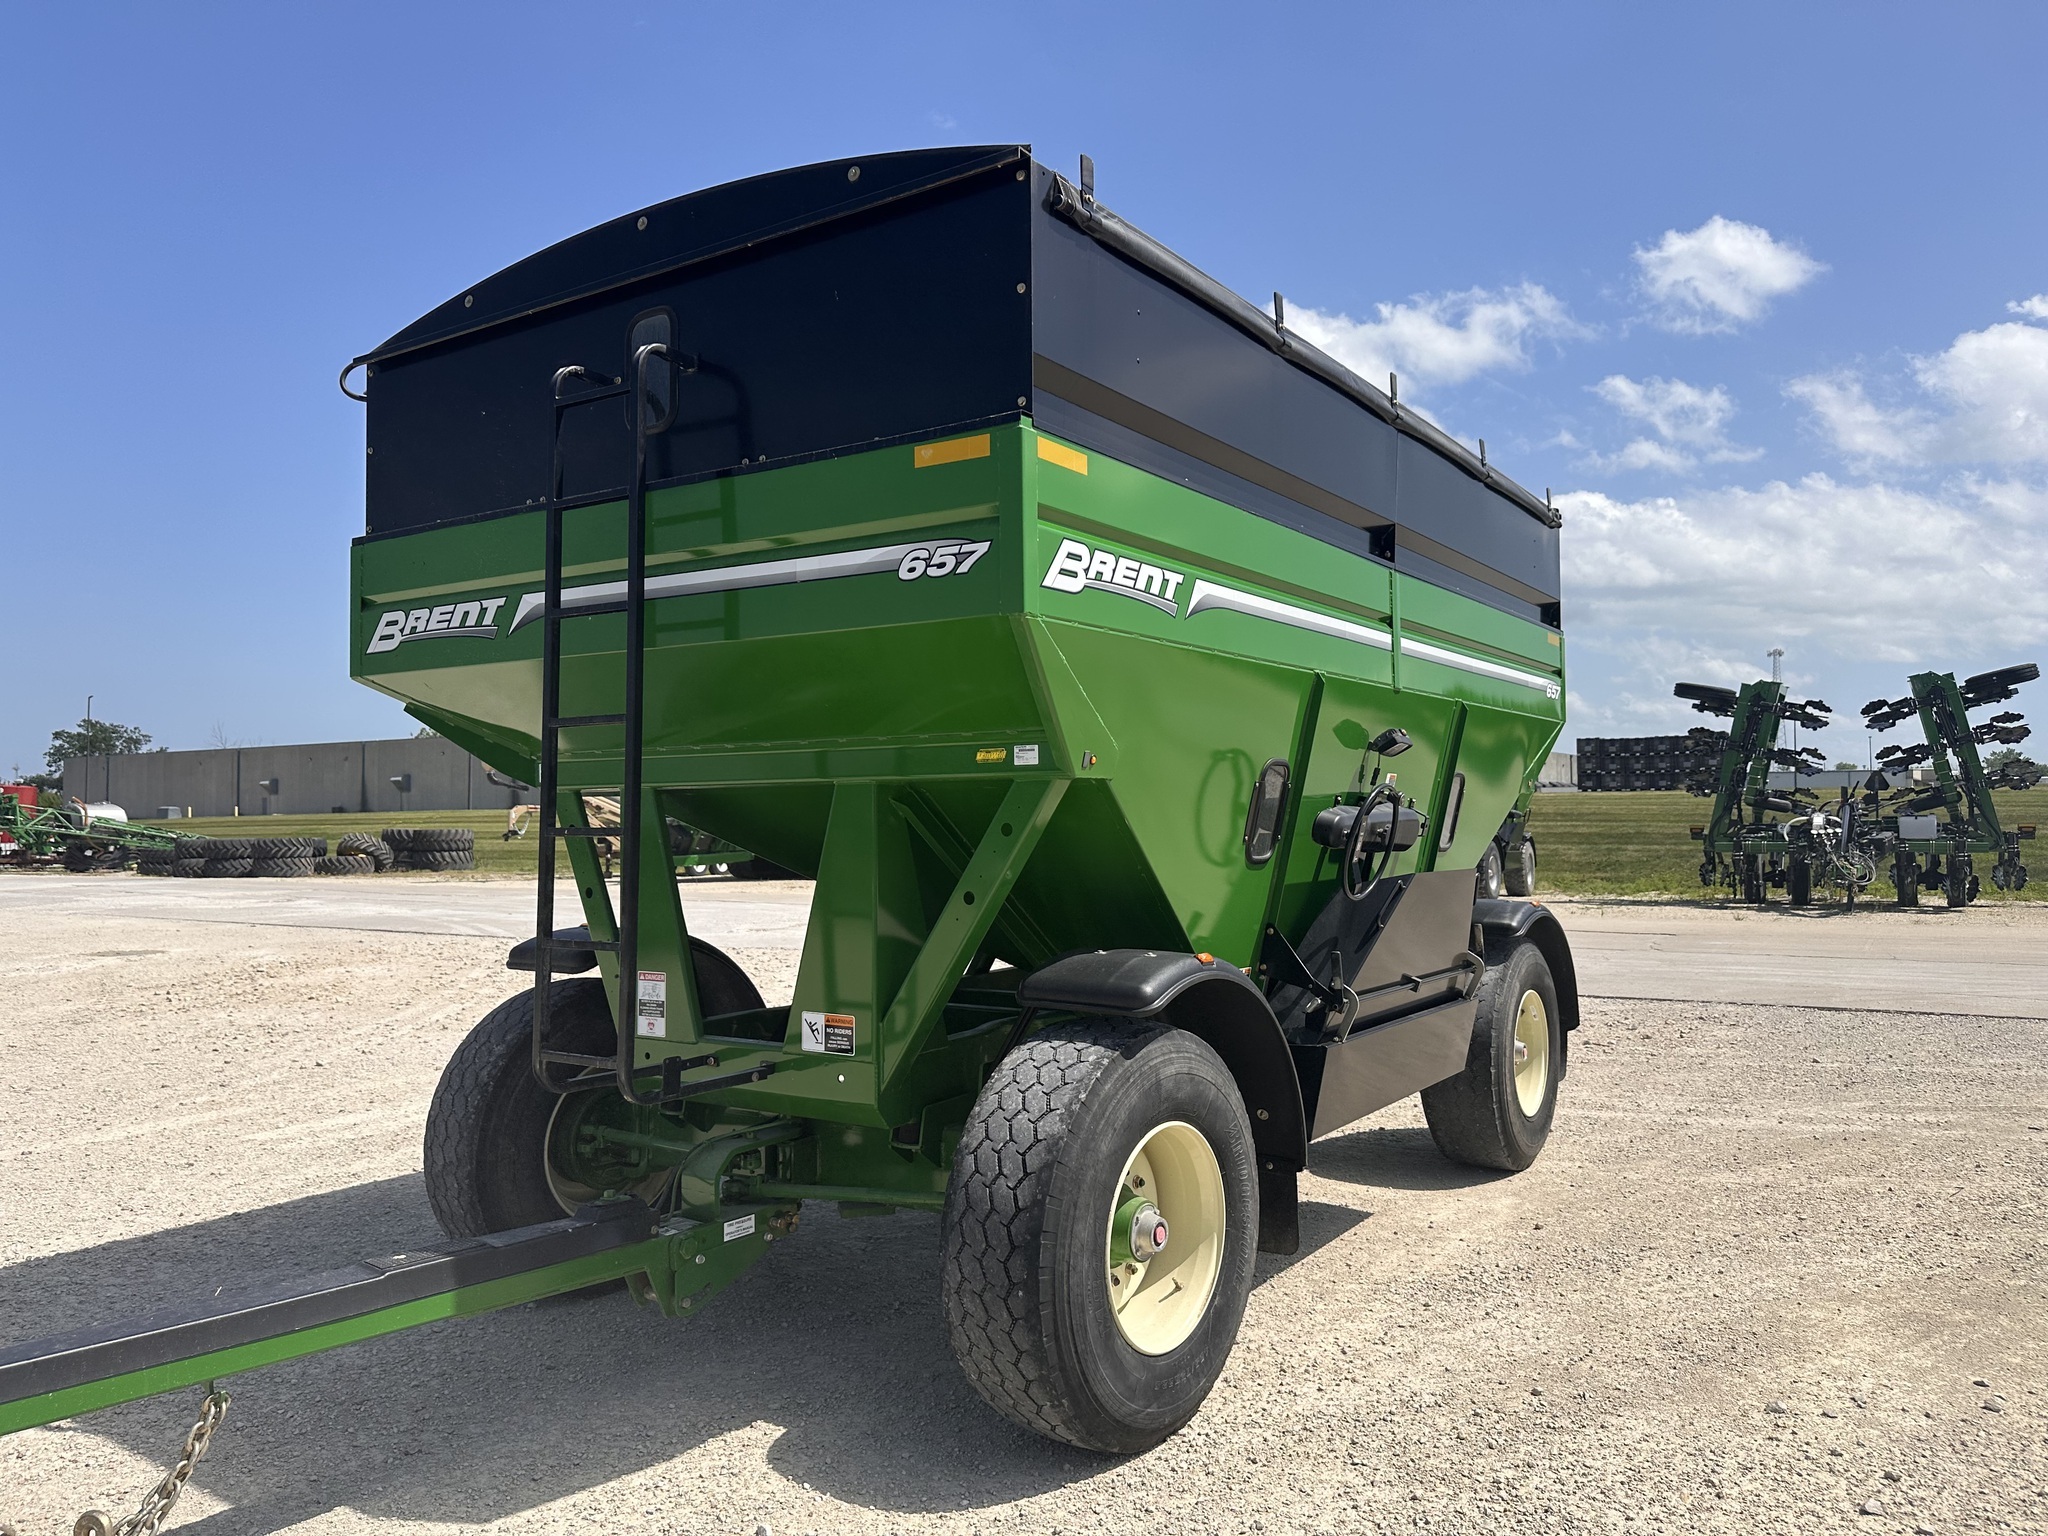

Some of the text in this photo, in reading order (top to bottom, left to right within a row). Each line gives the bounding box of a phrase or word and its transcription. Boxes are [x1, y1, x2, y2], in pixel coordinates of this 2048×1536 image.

[898, 541, 991, 580] 657
[1041, 538, 1184, 601] BRENT
[366, 596, 507, 653] BRENT
[1546, 684, 1561, 699] 657
